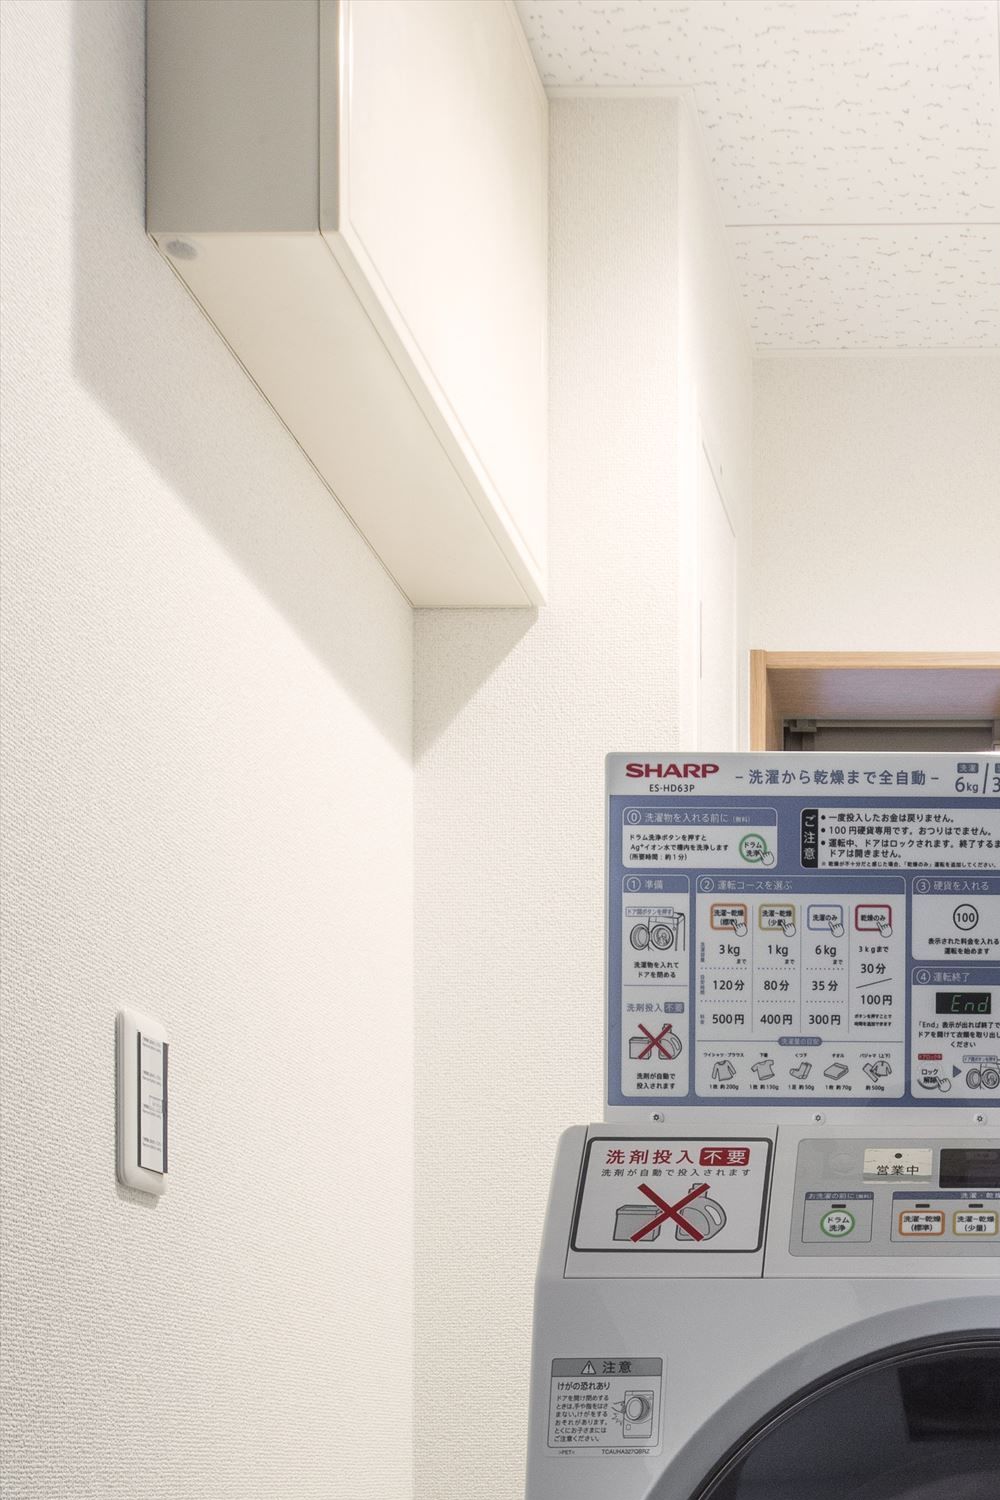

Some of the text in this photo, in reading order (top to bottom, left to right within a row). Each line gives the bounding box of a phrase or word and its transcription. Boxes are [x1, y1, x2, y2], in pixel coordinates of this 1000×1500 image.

[625, 763, 719, 778] SHARP
[748, 769, 926, 787] 洗濯から乾燥まで全自動
[649, 784, 695, 792] ES-HD63P
[645, 813, 728, 823] 洗濯物を入れる前に
[829, 814, 954, 823] 一度投入したお金は戻りません。
[804, 815, 816, 859] ご注意
[829, 850, 902, 858] ドアは開きません。
[645, 880, 663, 890] 準備
[718, 881, 793, 890] 運転コースを選ぶ
[933, 881, 989, 890] 硬貨を入れる
[813, 914, 837, 922] 洗濯のみ
[861, 914, 886, 922] 乾燥のみ
[957, 913, 975, 922] 100
[634, 961, 679, 969] 洗濯物を入れて
[933, 973, 970, 982] 運転終了
[627, 1003, 663, 1013] 洗剤投入
[951, 995, 989, 1013] End
[637, 1082, 675, 1090] 投入されます
[606, 1150, 746, 1164] 洗剤投入 不要
[601, 1169, 750, 1177] 洗剤が自動で投入されます
[876, 1165, 919, 1176] 営業中
[603, 1361, 631, 1373] 注意
[558, 1382, 610, 1390] けがの恐れあり
